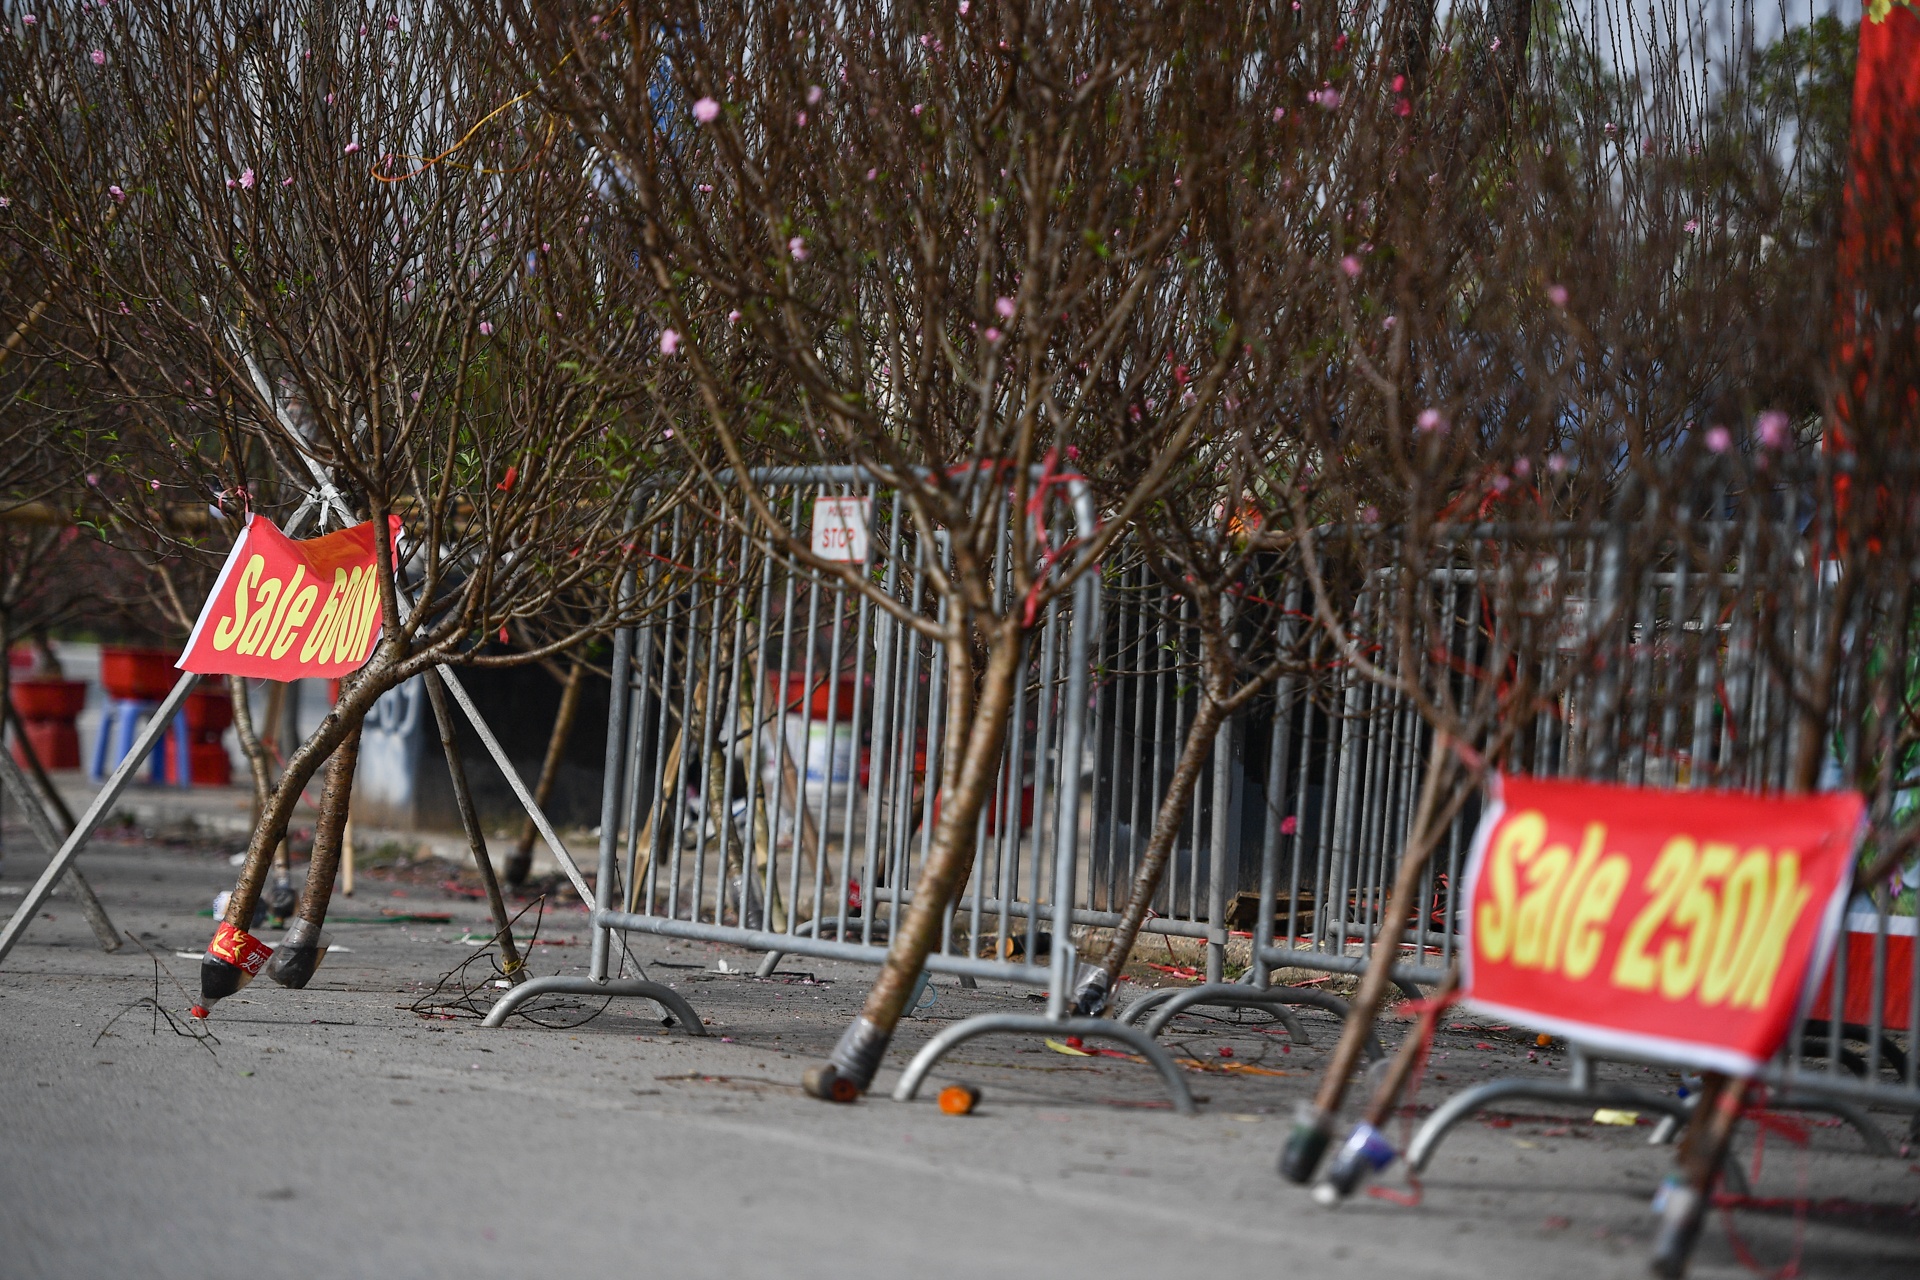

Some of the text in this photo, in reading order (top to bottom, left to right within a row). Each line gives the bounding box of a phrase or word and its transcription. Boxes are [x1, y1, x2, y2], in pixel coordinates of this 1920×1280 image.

[822, 527, 856, 548] STOP
[828, 506, 853, 517] POCE
[213, 554, 319, 660] Sale
[1477, 809, 1631, 981] Sale
